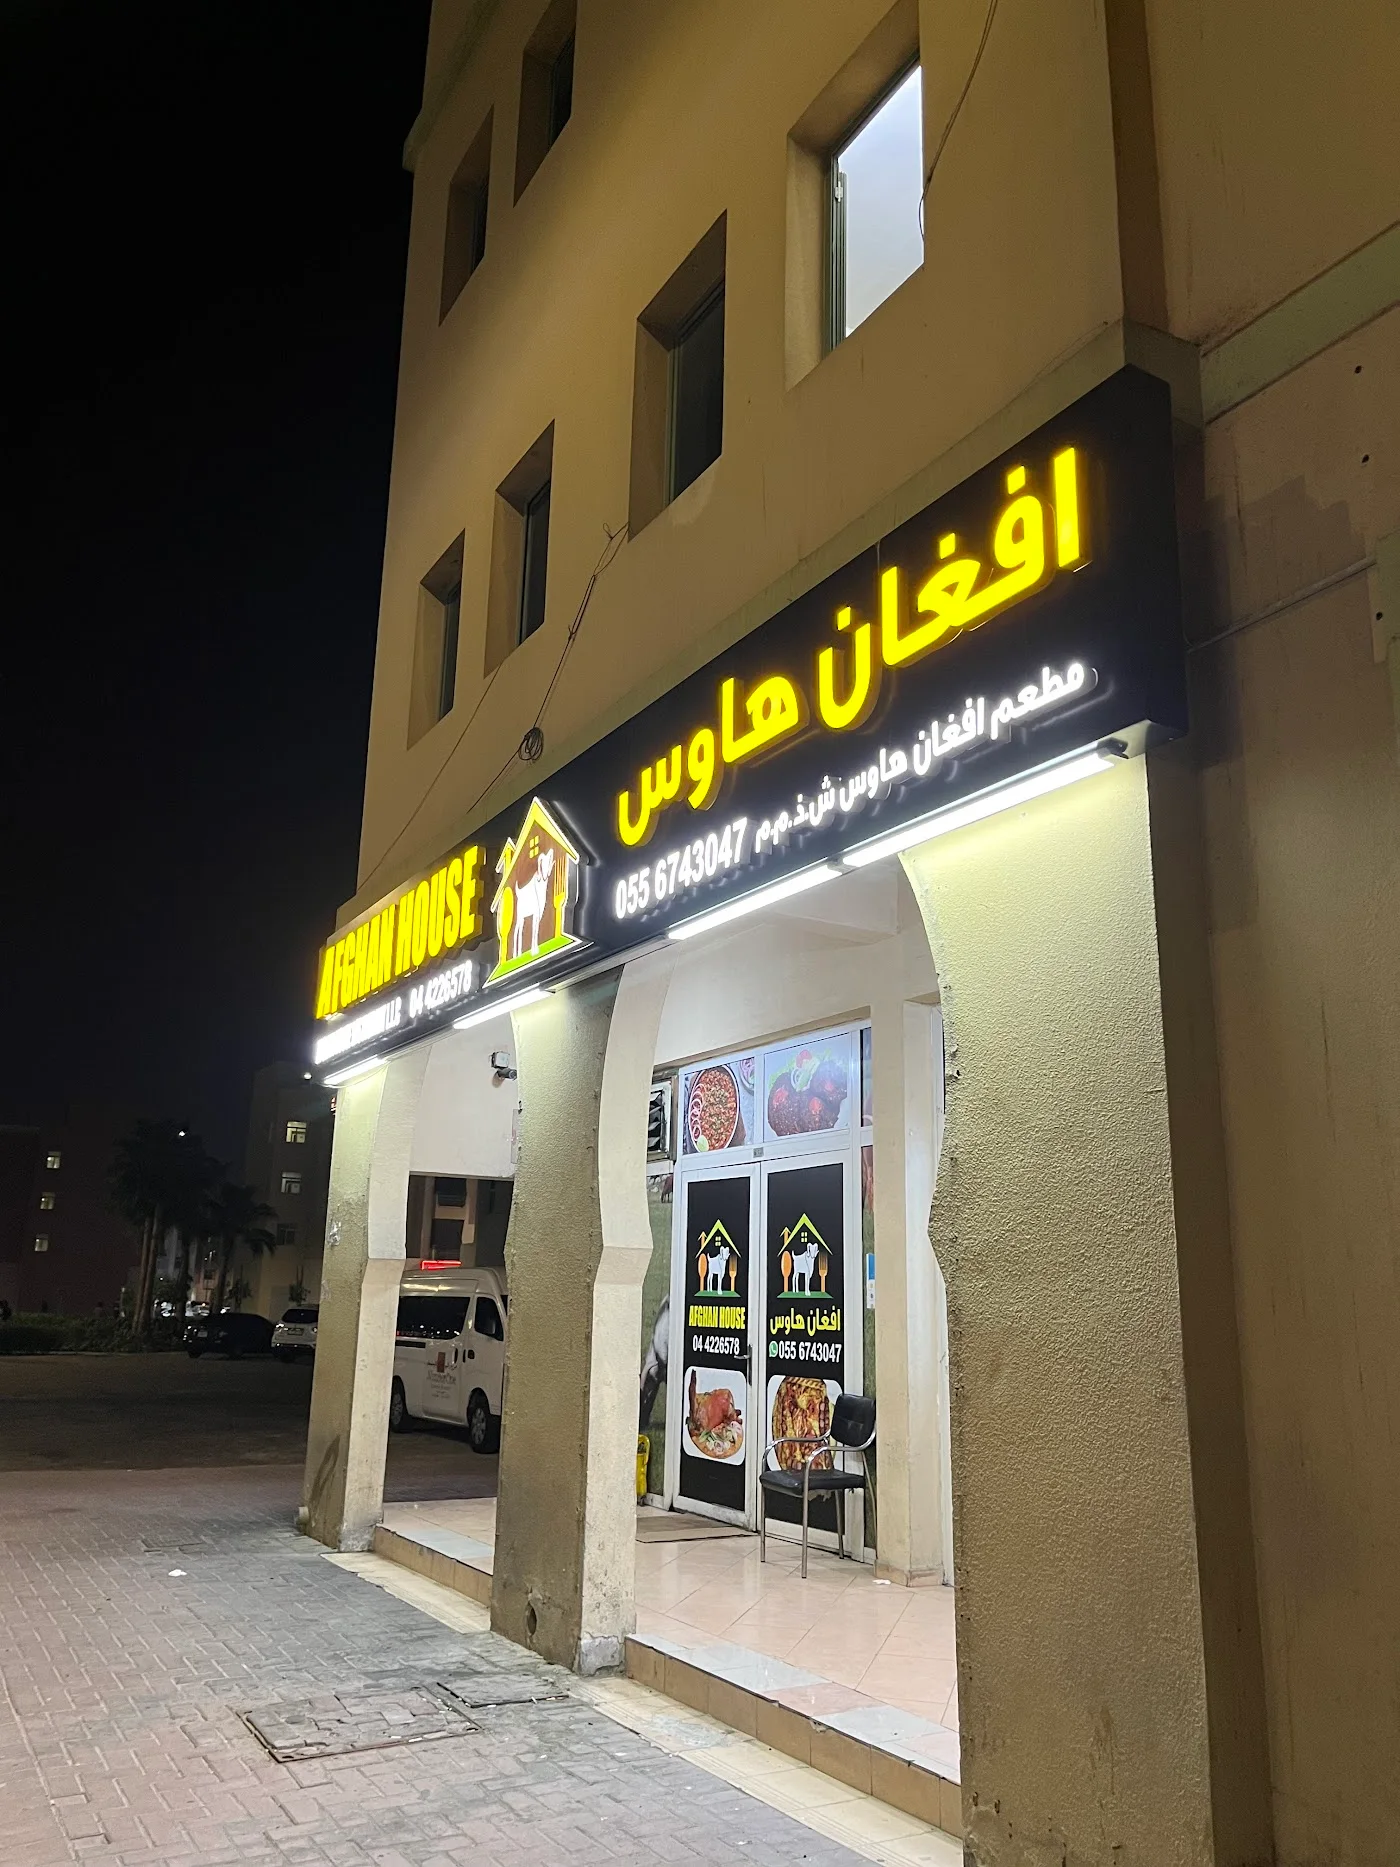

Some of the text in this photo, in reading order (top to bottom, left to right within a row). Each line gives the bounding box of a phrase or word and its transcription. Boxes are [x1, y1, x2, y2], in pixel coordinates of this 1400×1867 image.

[617, 446, 1081, 847] افغان هاوس
[990, 662, 1085, 741] مطعم
[912, 697, 985, 777] افغان
[839, 747, 908, 813] هاوس
[615, 816, 748, 919] 055 6743047
[315, 844, 479, 1020] AFGHAN HOUSE
[409, 982, 424, 1019] 04
[688, 1304, 746, 1330] AFGHAN HOUSE
[692, 1334, 740, 1355] 04 4226578
[769, 1305, 841, 1336] افغان هاوس
[778, 1340, 842, 1363] 055 6743047
